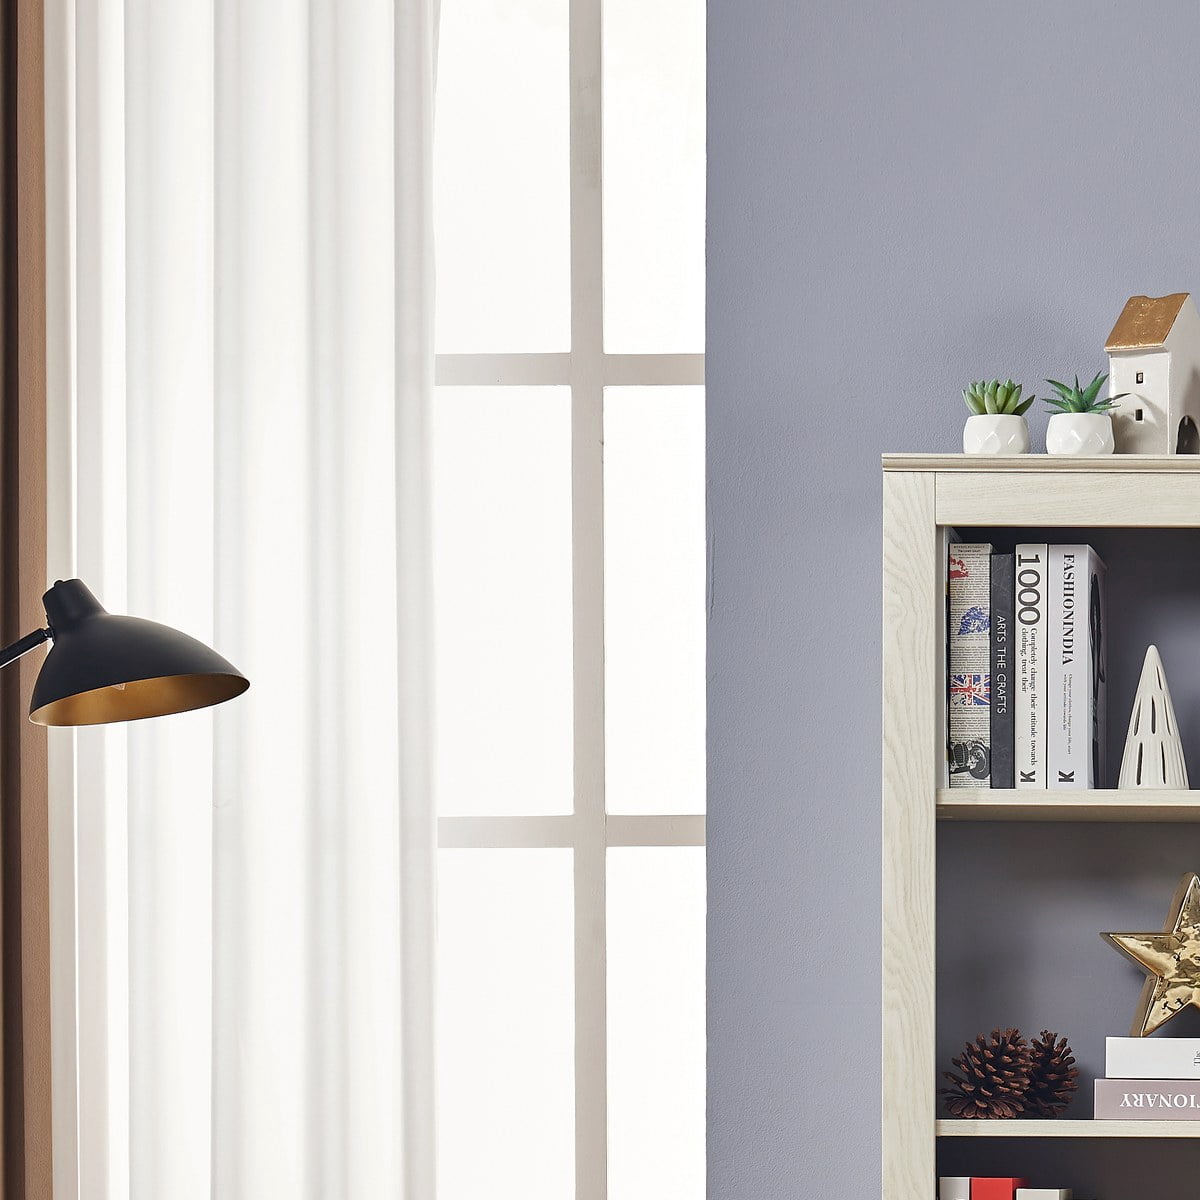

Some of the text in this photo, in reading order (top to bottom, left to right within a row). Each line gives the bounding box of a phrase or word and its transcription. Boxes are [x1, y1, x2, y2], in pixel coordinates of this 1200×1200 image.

[1017, 554, 1041, 625] 1000
[1019, 628, 1028, 656] clothing,
[996, 615, 1007, 714] ARTS THE CRAFTS
[1021, 677, 1029, 693] their
[1028, 628, 1038, 766] Completely change their attitude towards
[1020, 770, 1036, 783] K
[1058, 770, 1075, 783] K
[1193, 1051, 1200, 1066] The
